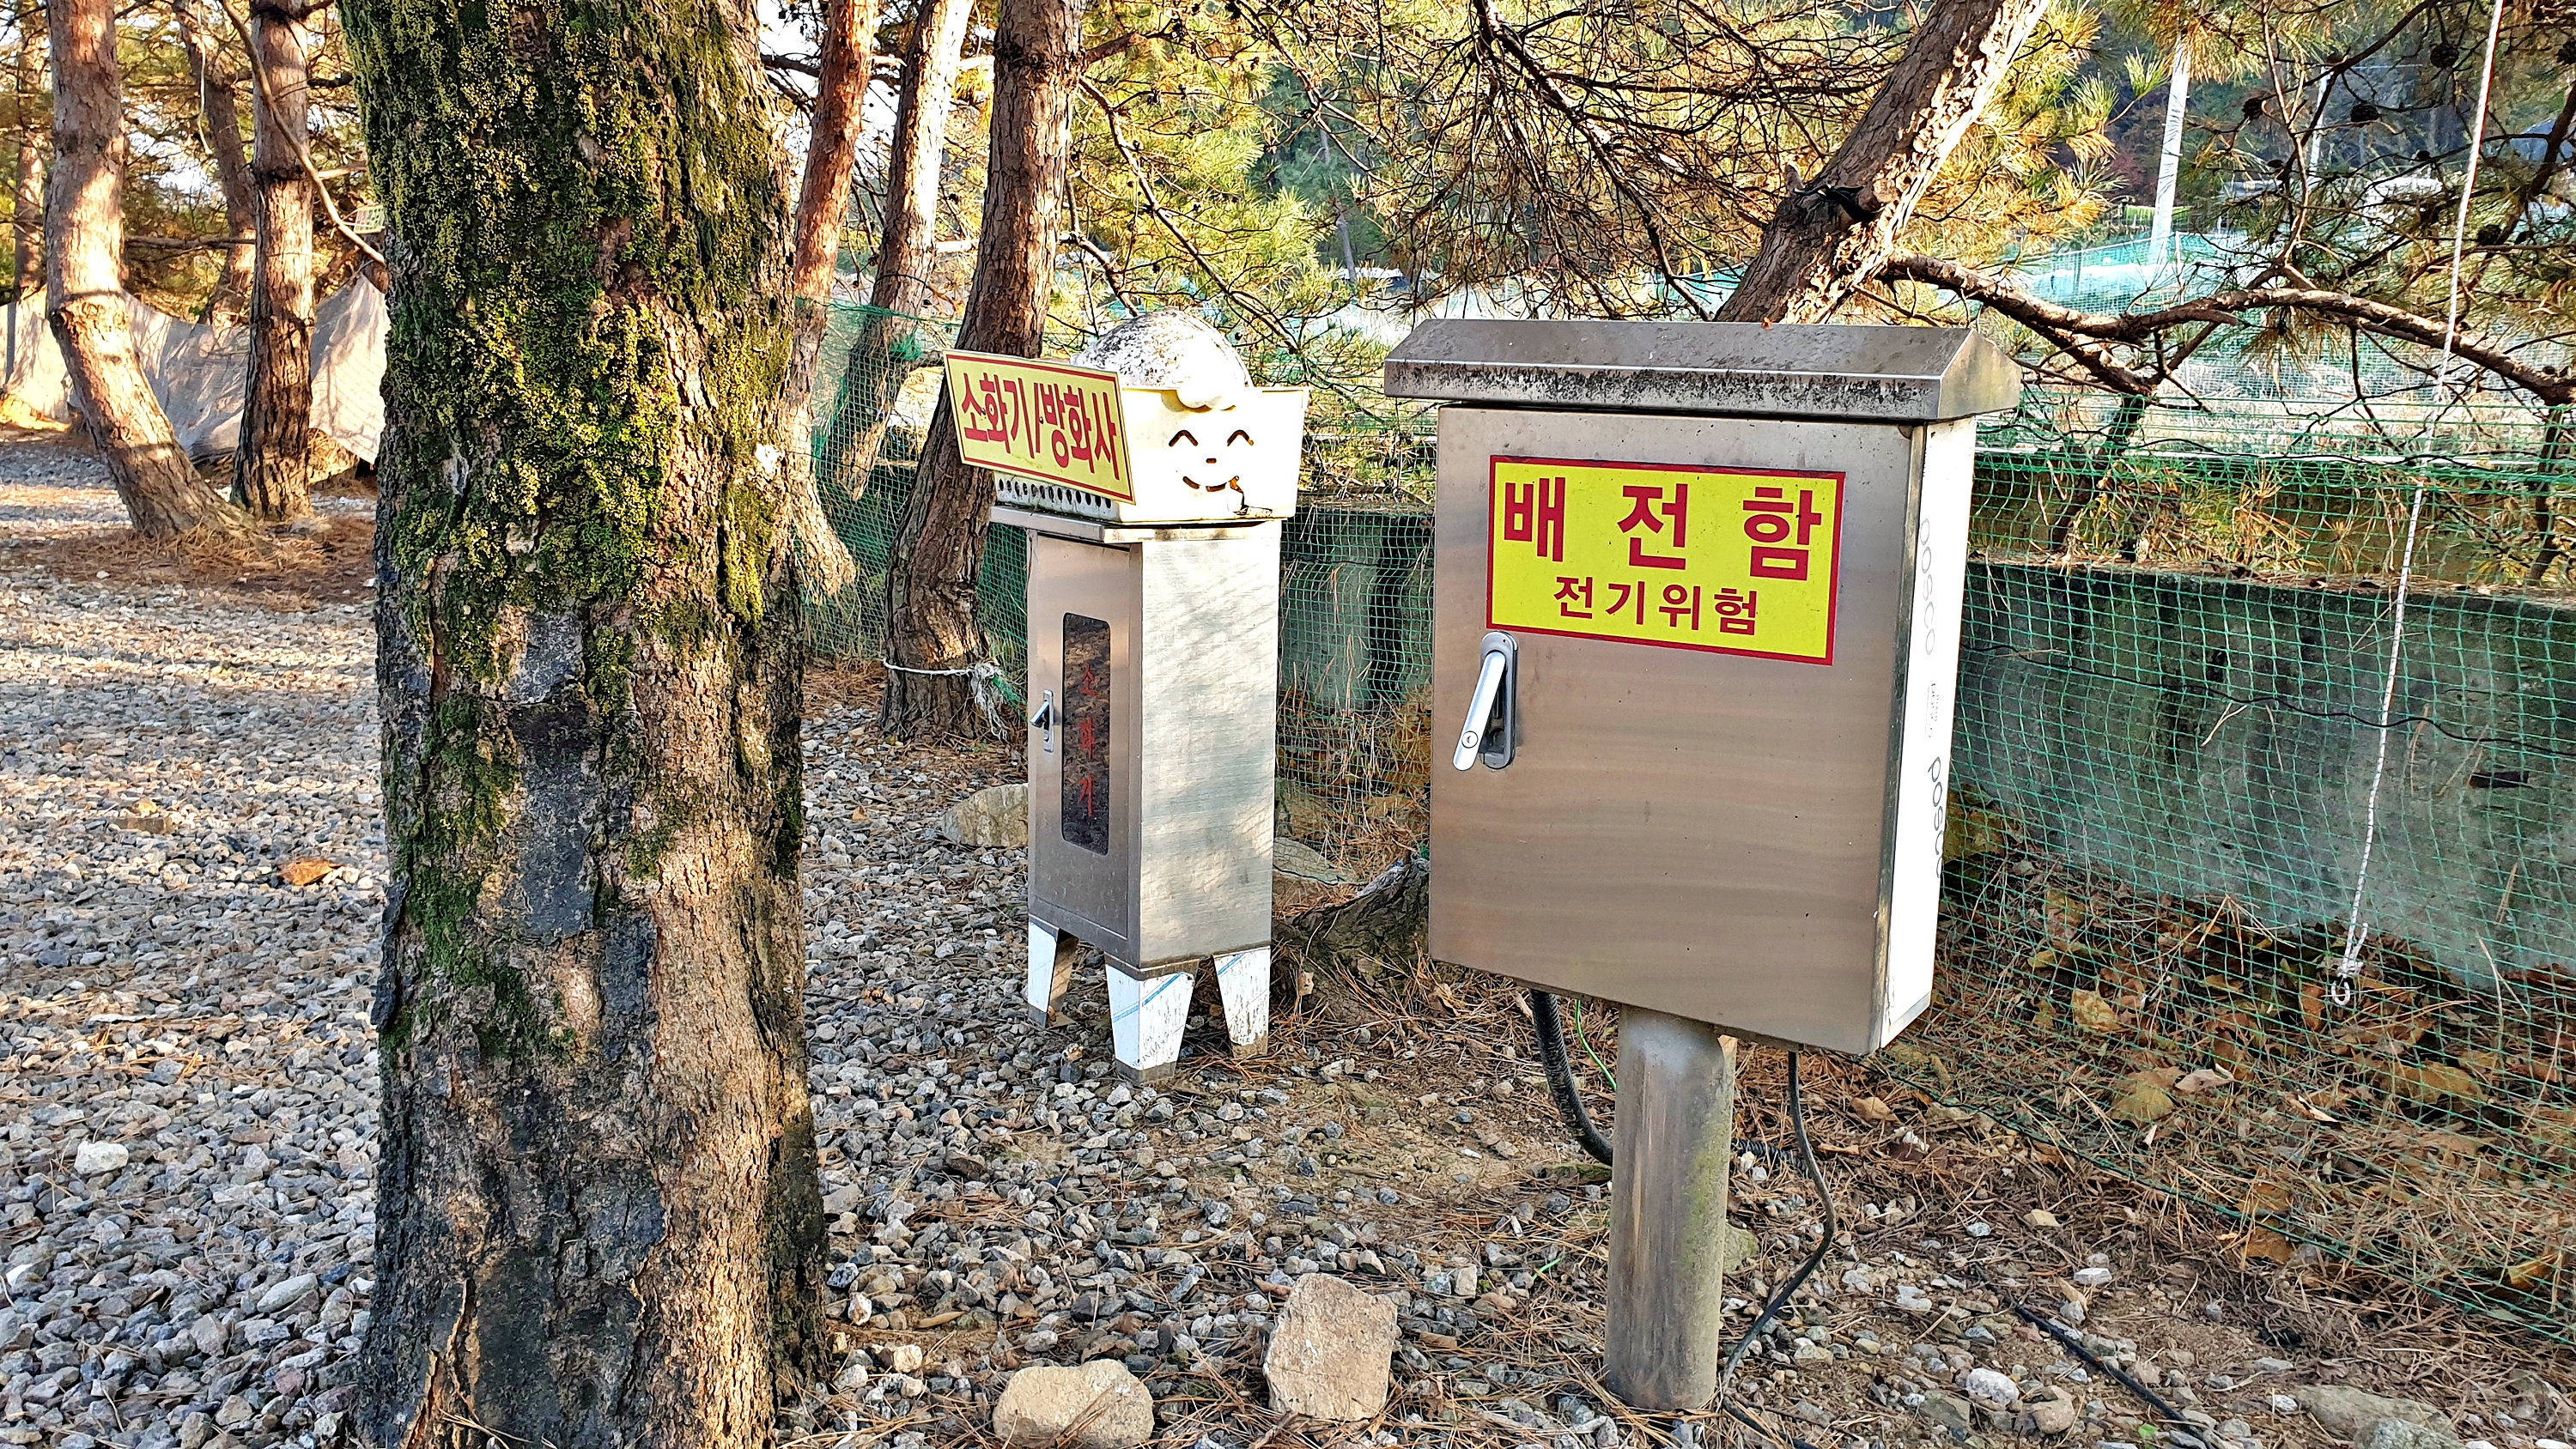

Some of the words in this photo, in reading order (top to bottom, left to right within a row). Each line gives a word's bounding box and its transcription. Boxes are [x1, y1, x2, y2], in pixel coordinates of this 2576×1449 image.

[960, 372, 1121, 481] 소화기/방화사
[1553, 576, 1758, 636] 전기위험
[1078, 663, 1097, 817] 소화기
